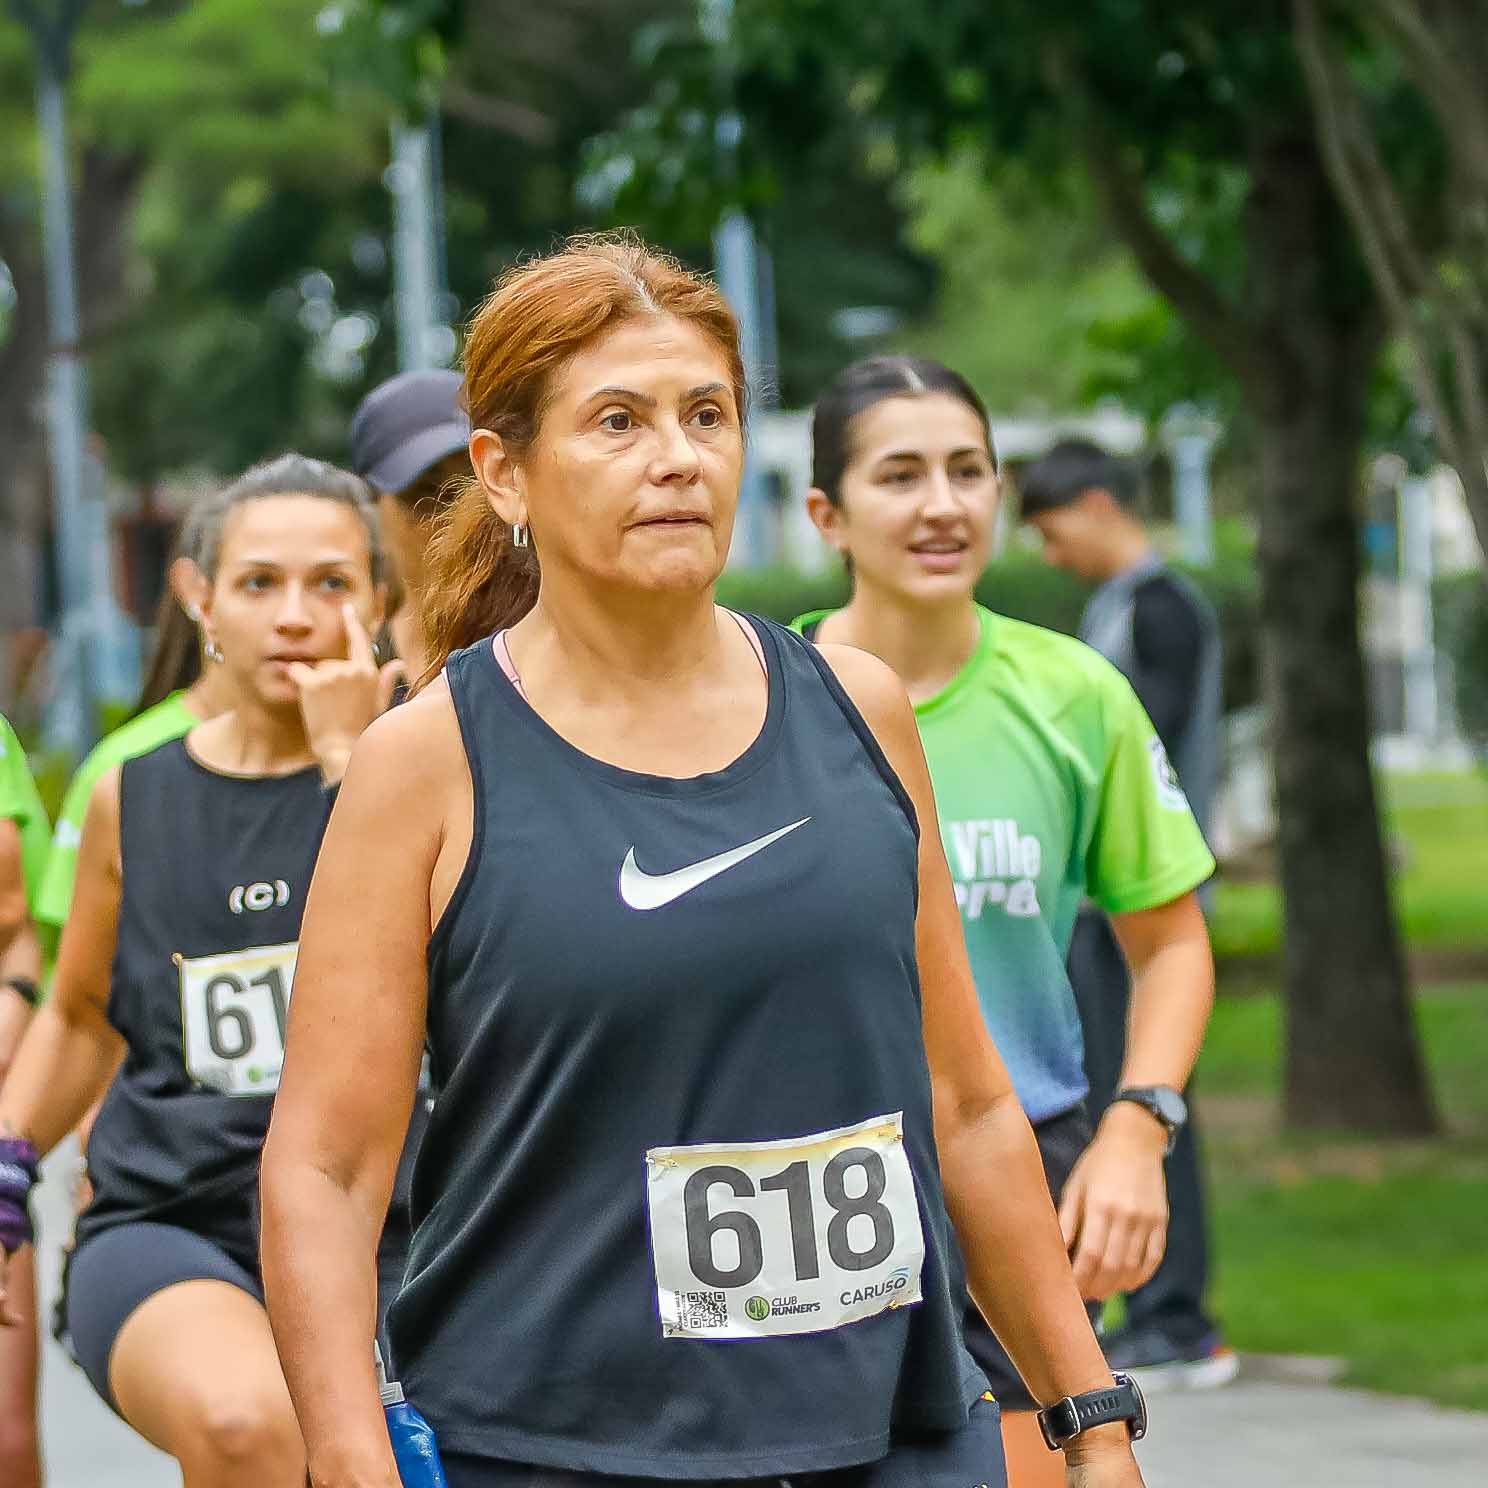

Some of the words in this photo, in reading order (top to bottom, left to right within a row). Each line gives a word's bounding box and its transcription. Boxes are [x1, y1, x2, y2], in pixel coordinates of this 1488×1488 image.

[683, 1146, 895, 1289] 618
[771, 1295, 798, 1308] CLUB
[839, 1276, 907, 1306] CARUSO
[771, 1301, 821, 1316] RUNNER'S
